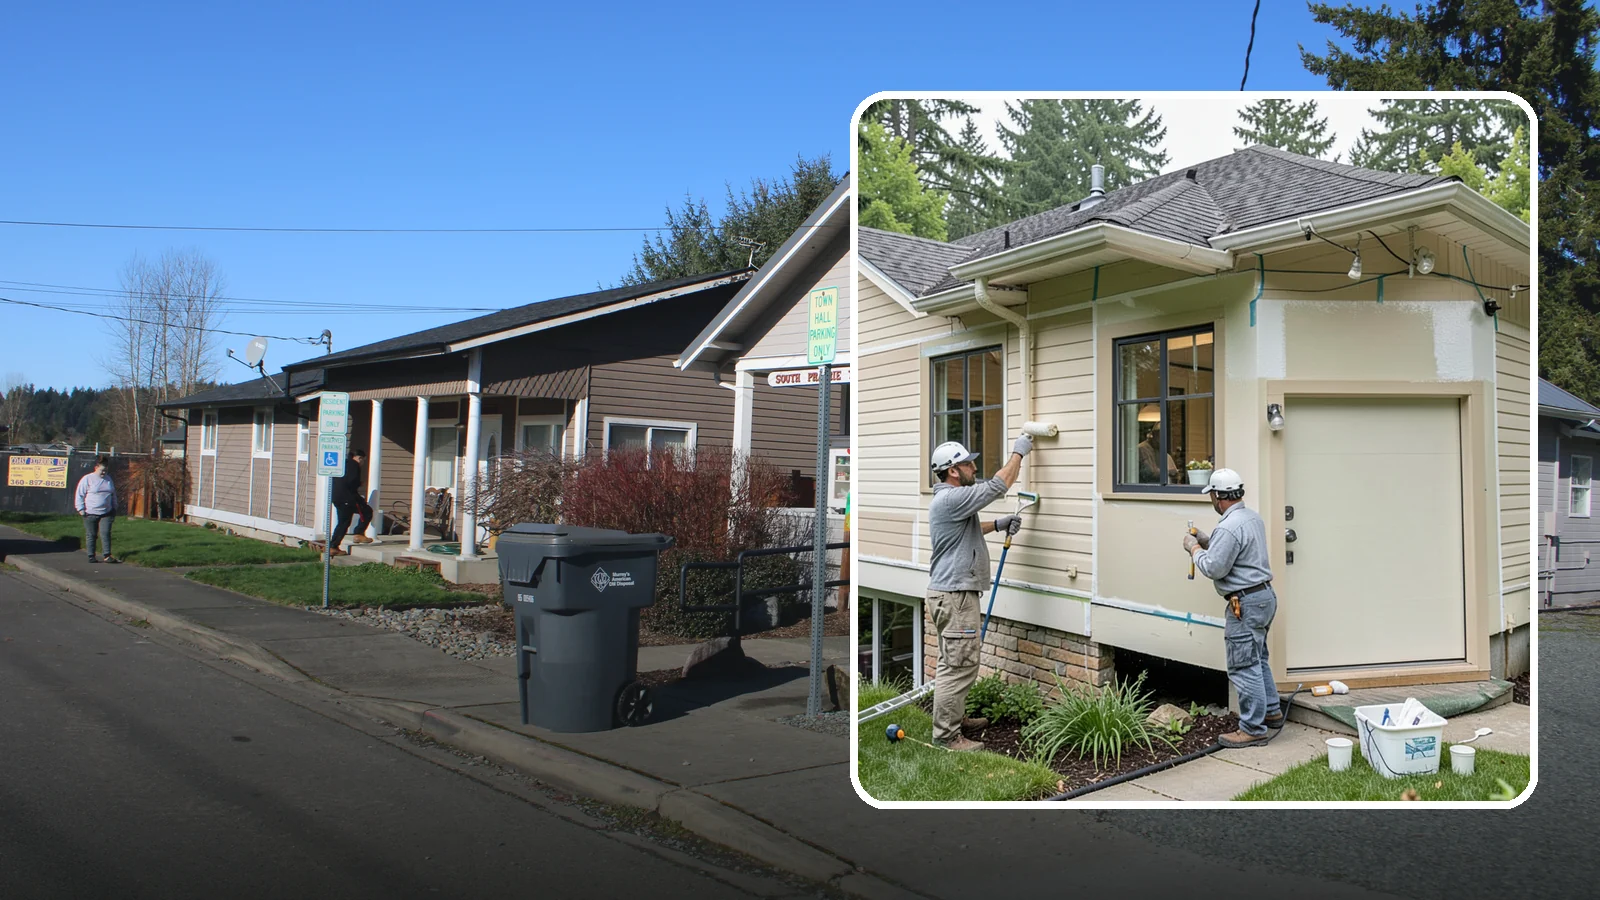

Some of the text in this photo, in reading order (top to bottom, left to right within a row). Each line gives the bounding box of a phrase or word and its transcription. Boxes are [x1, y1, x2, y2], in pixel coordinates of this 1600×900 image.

[815, 295, 832, 307] TOWN
[815, 312, 831, 324] HALL
[810, 327, 835, 340] PARKING
[814, 344, 830, 357] ONLY
[776, 373, 800, 384] SOUTH
